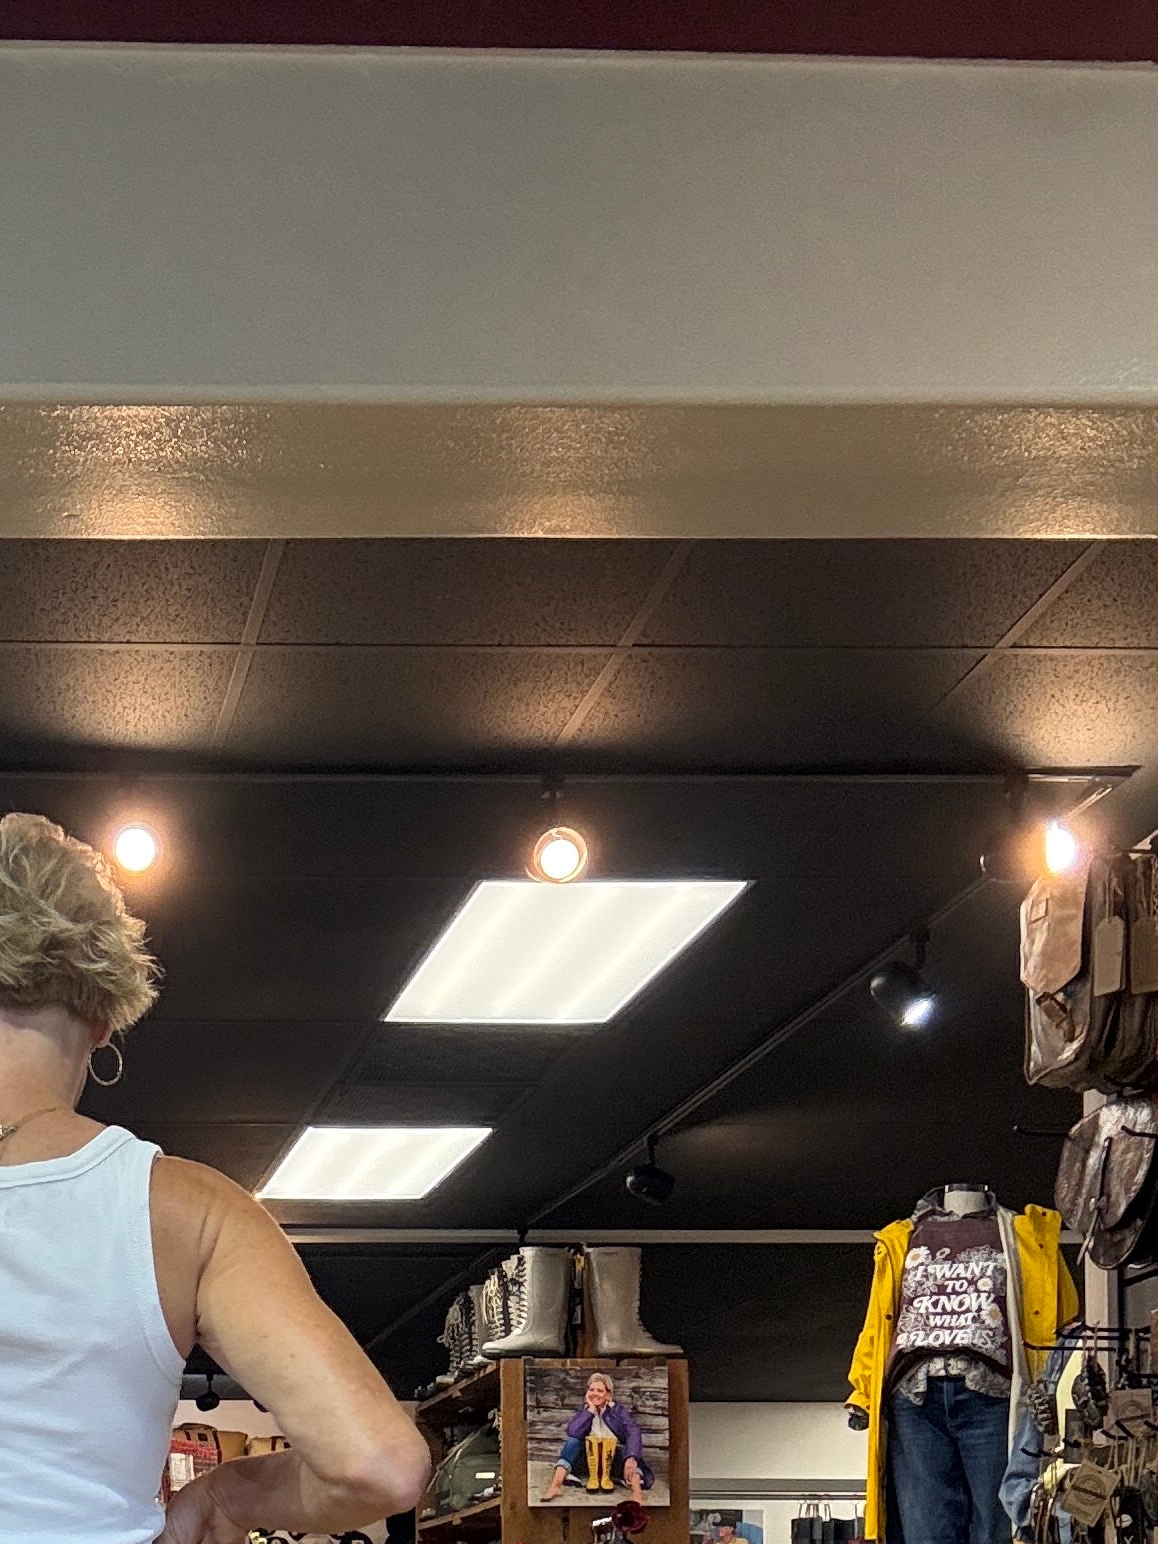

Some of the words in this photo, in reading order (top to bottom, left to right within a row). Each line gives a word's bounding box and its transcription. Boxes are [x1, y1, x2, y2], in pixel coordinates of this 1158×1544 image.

[928, 1262, 998, 1280] WANT
[944, 1280, 969, 1293] TO
[913, 1293, 995, 1314] KNOW
[928, 1313, 975, 1327] WHAT
[909, 1328, 971, 1347] LOVE
